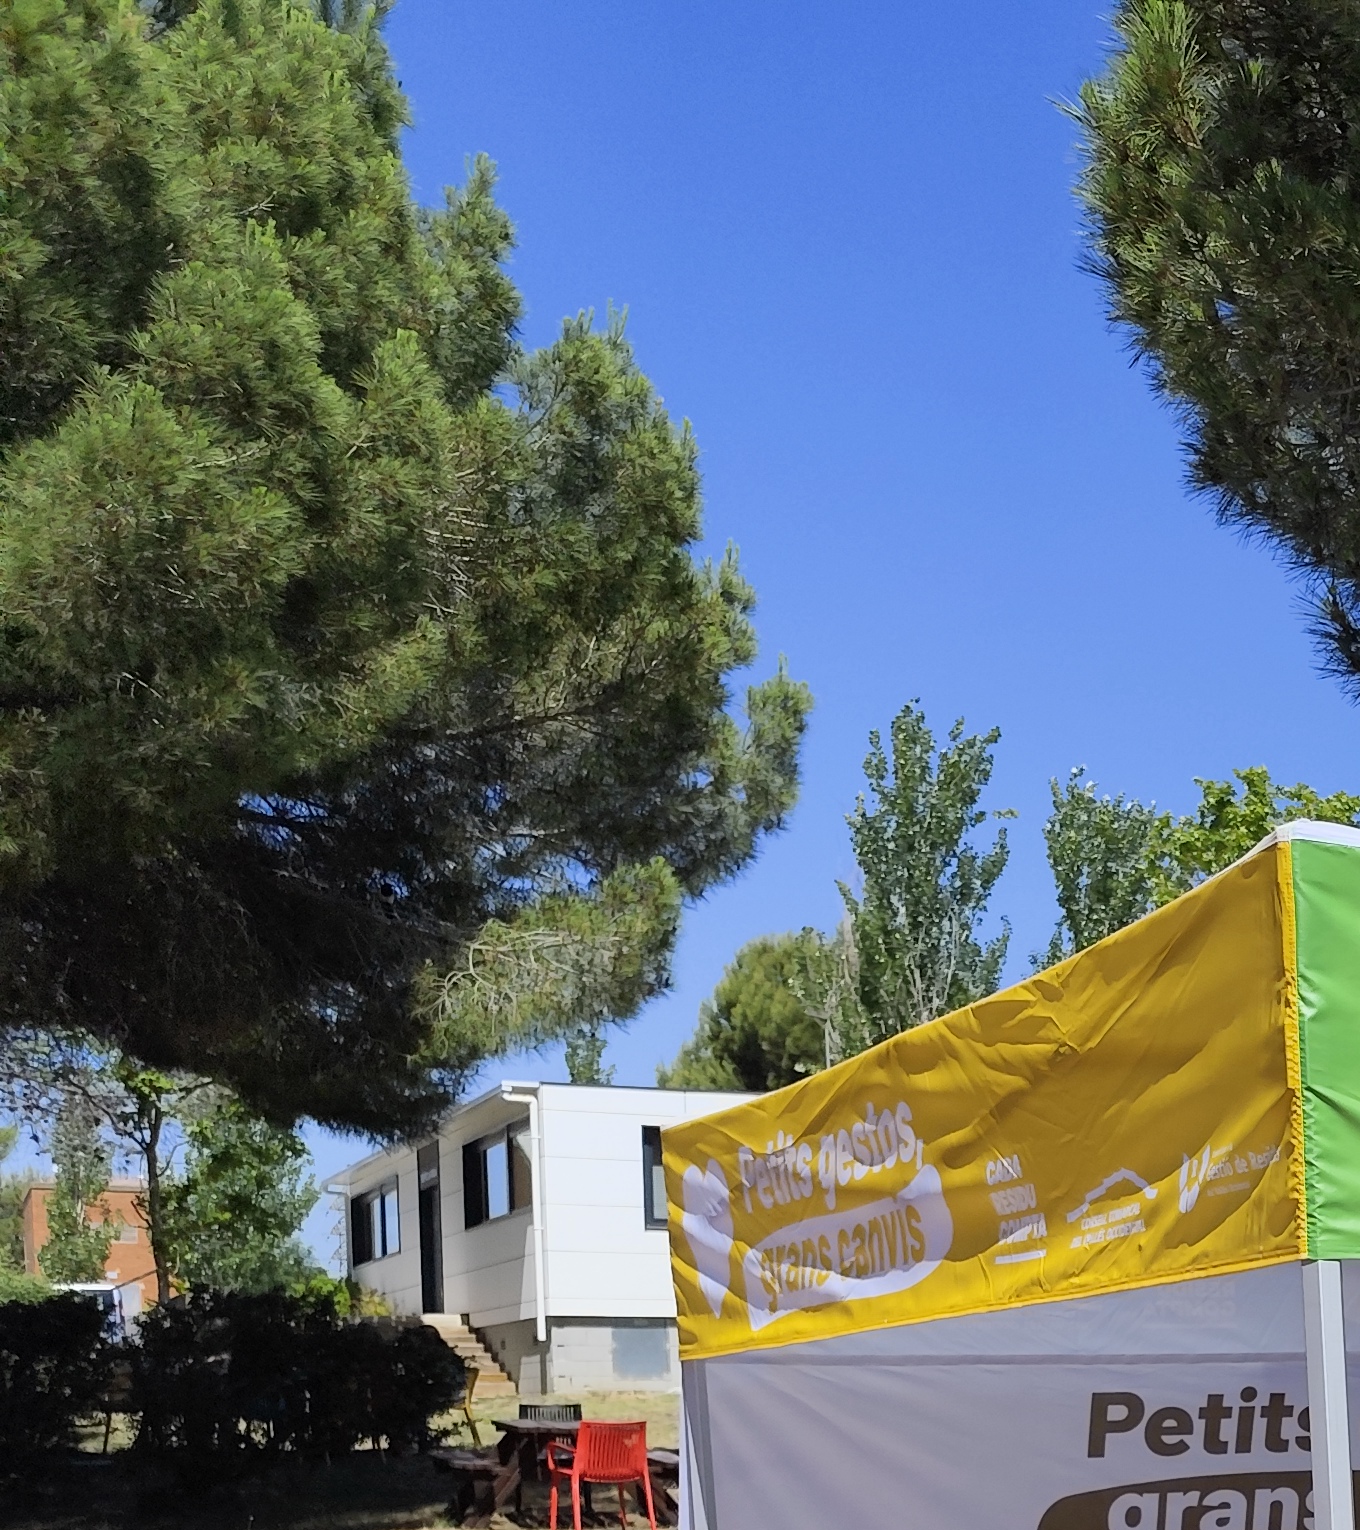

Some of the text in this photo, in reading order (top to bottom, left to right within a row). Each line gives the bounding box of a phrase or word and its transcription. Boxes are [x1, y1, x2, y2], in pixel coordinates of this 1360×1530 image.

[738, 1101, 924, 1214] Petits gestos,
[986, 1154, 1023, 1186] CADA
[760, 1205, 926, 1315] grans canvis
